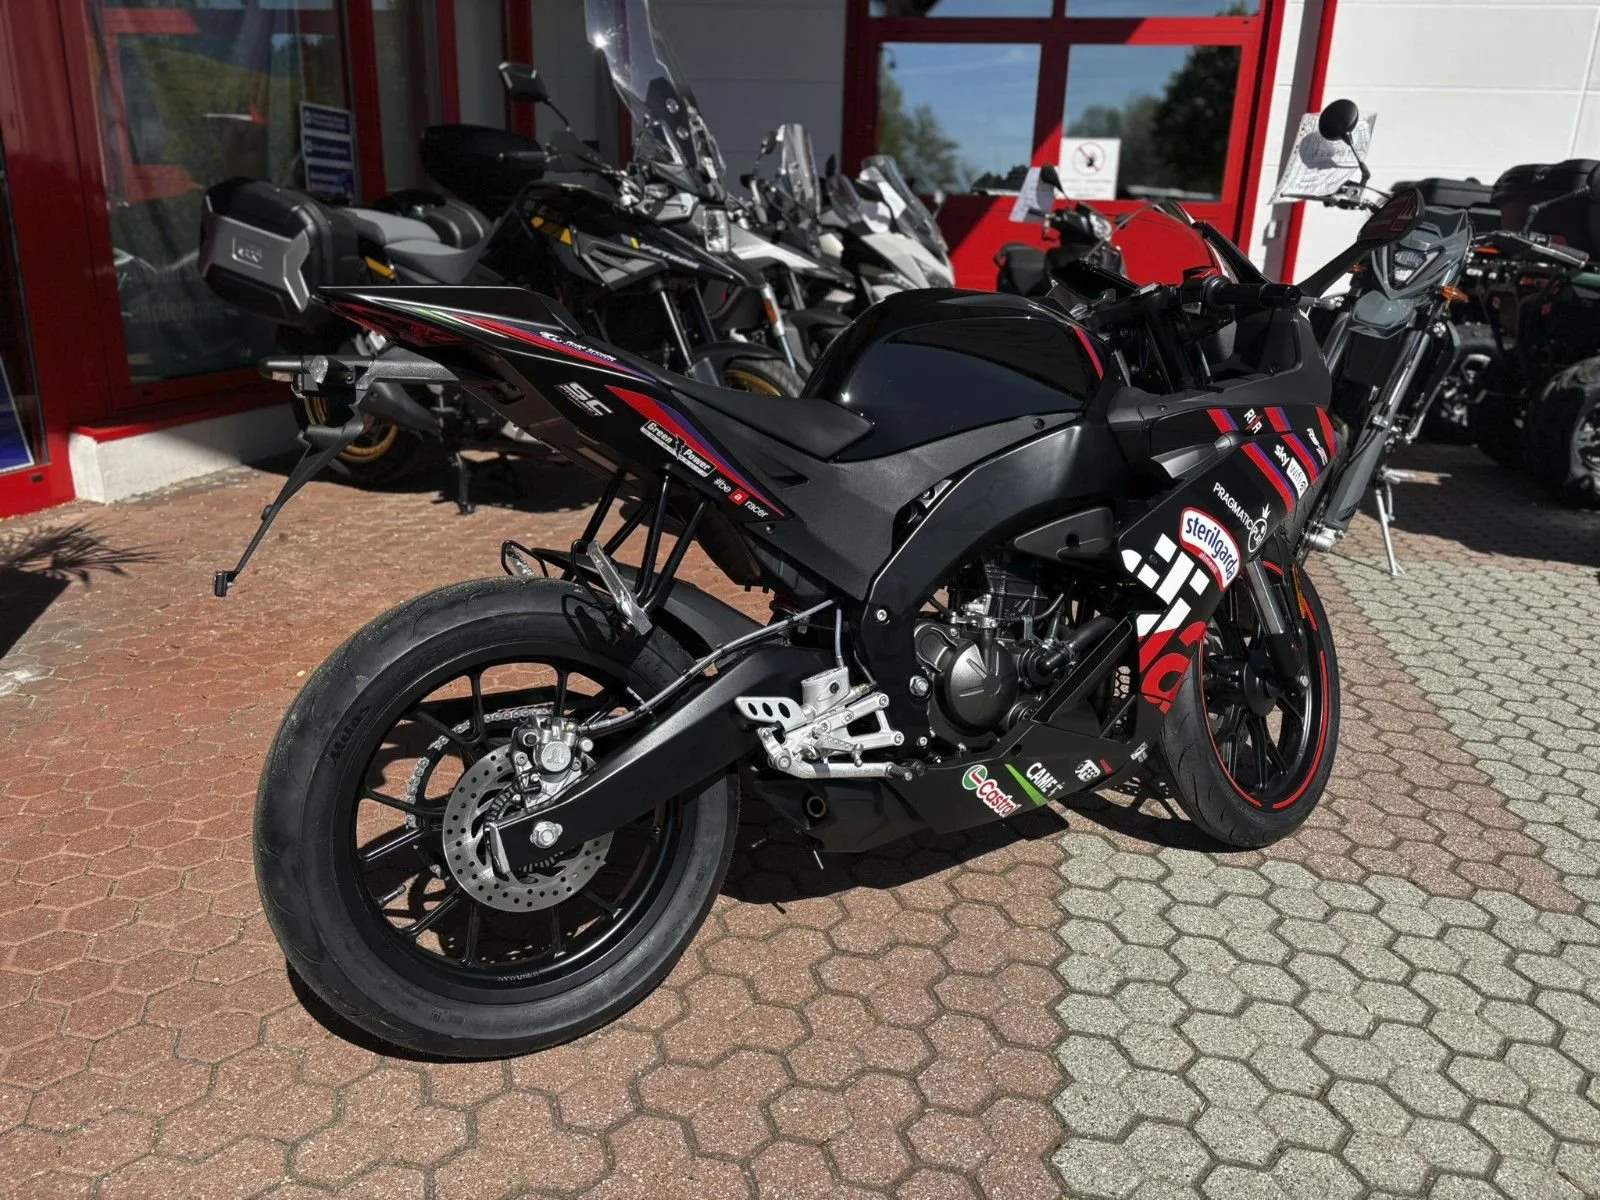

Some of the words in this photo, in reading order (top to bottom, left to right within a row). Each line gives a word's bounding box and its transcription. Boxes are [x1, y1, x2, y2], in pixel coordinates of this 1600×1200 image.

[647, 422, 674, 444] Green
[683, 448, 711, 471] Power
[1274, 444, 1290, 467] sky
[744, 500, 769, 518] racer
[1213, 482, 1254, 531] PRAGMATIC
[1186, 517, 1238, 580] sterilgarda
[977, 780, 1020, 817] Castrol
